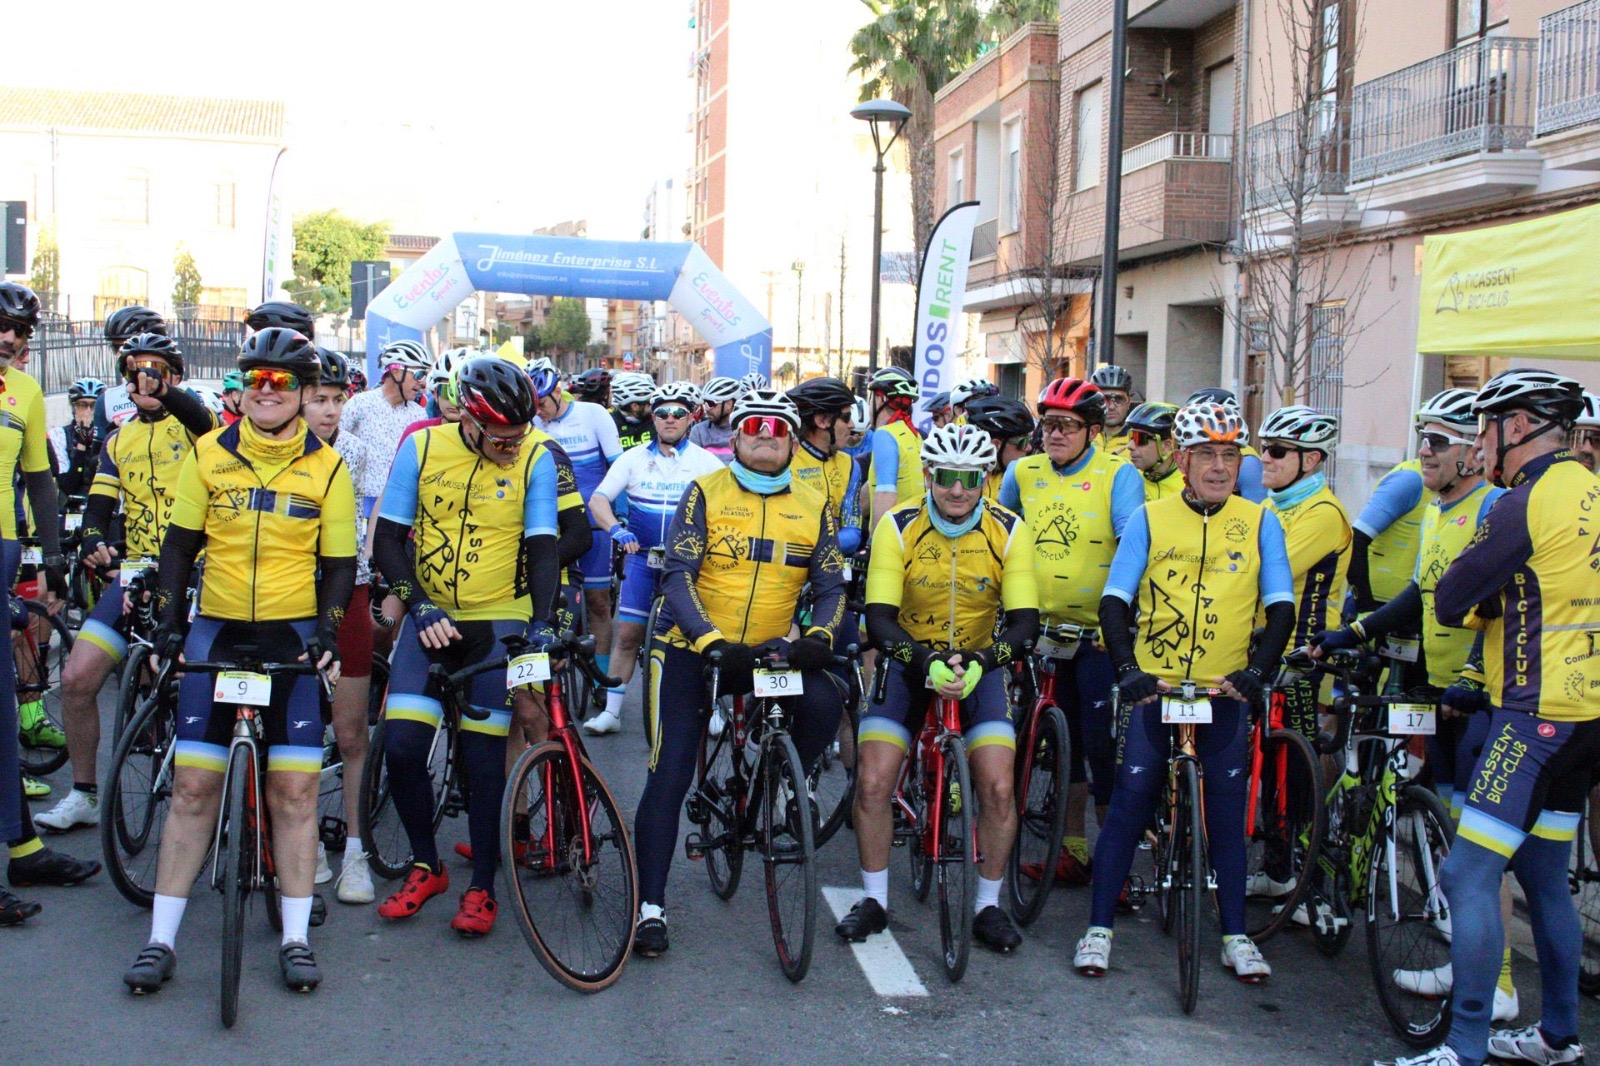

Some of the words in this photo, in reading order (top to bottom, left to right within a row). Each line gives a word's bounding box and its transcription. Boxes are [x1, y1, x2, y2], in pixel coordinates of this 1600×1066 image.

[476, 244, 549, 272] Jiménez
[552, 251, 633, 270] Enterprise
[935, 238, 958, 304] RENT
[393, 262, 449, 310] Eventos
[1464, 267, 1518, 289] PICASSENT
[691, 271, 742, 327] Eventos
[1466, 289, 1510, 311] BICI-CLUB
[423, 471, 484, 492] AMUSEMENT
[1032, 502, 1081, 532] PICASSENT
[432, 494, 483, 594] PICASSENT
[1153, 545, 1218, 565] AMUSEMENT
[706, 554, 740, 571] BICI-CLUB
[1161, 569, 1219, 670] PICASSENT
[1513, 572, 1529, 687] BICI-CLUB
[517, 662, 535, 679] 22
[769, 675, 788, 689] 30
[238, 680, 248, 696] 9
[1178, 704, 1197, 717] 11
[1284, 682, 1303, 733] BICI-CLU
[1299, 679, 1316, 741] PICASSEN
[1406, 712, 1424, 727] 17
[1468, 721, 1518, 804] PICASSENT
[1486, 740, 1528, 805] BICI-CLUB
